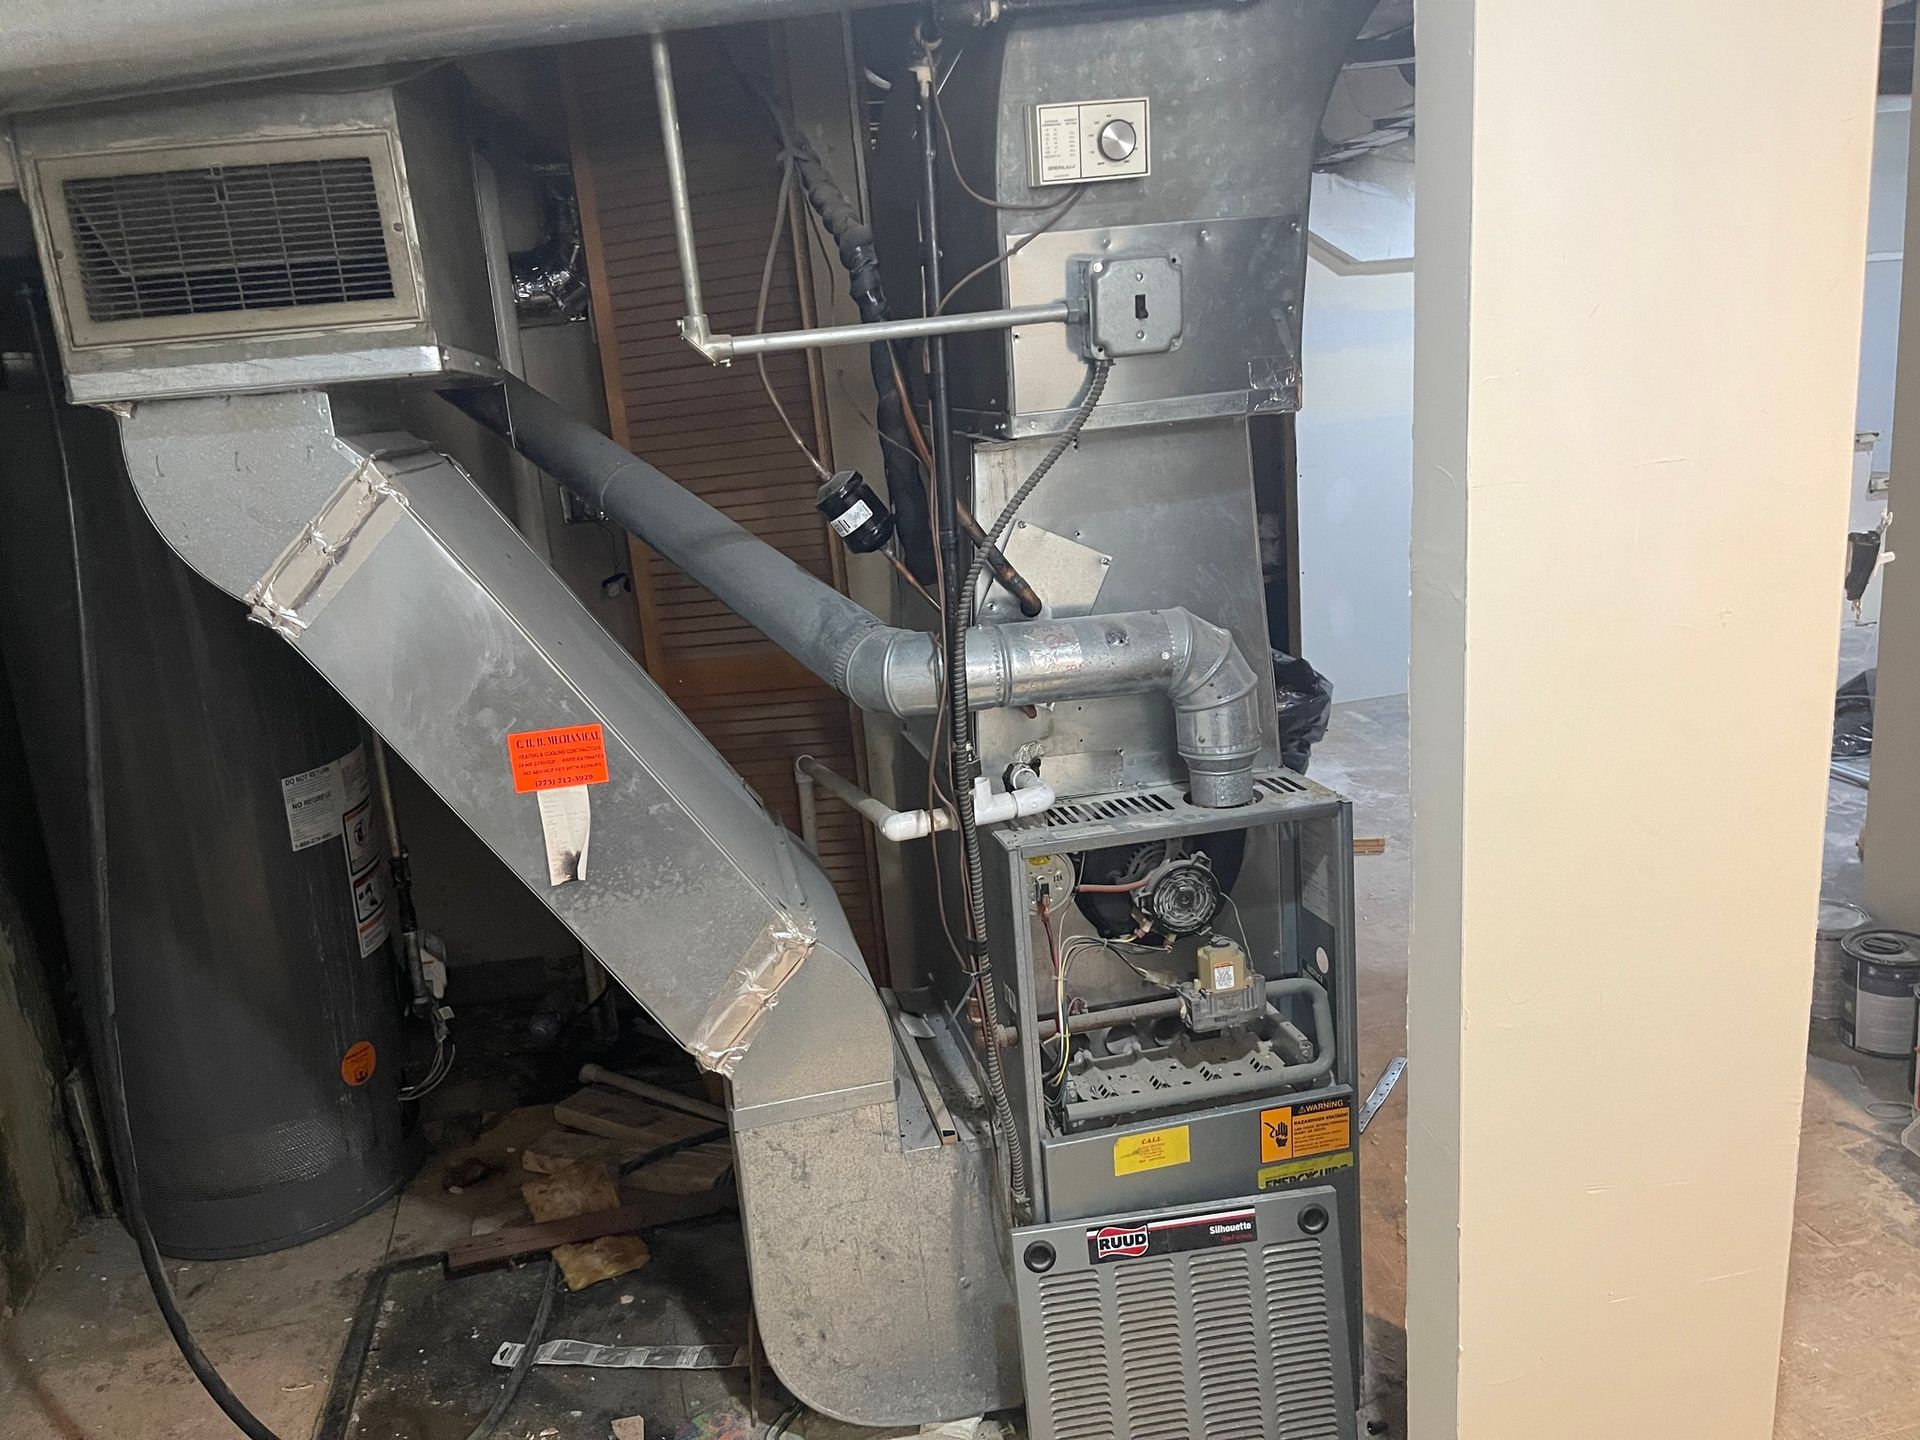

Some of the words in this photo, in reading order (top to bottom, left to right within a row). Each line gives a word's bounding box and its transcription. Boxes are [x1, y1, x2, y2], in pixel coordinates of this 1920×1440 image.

[547, 731, 600, 746] MECHANICAL
[285, 778, 295, 786] DO
[296, 774, 308, 782] NOT
[292, 801, 303, 810] NO
[1305, 1099, 1344, 1112] WARNING
[1265, 1164, 1348, 1187] ENERGYGUI
[1209, 1221, 1252, 1235] Silhouette
[1099, 1233, 1147, 1251] RUUD
